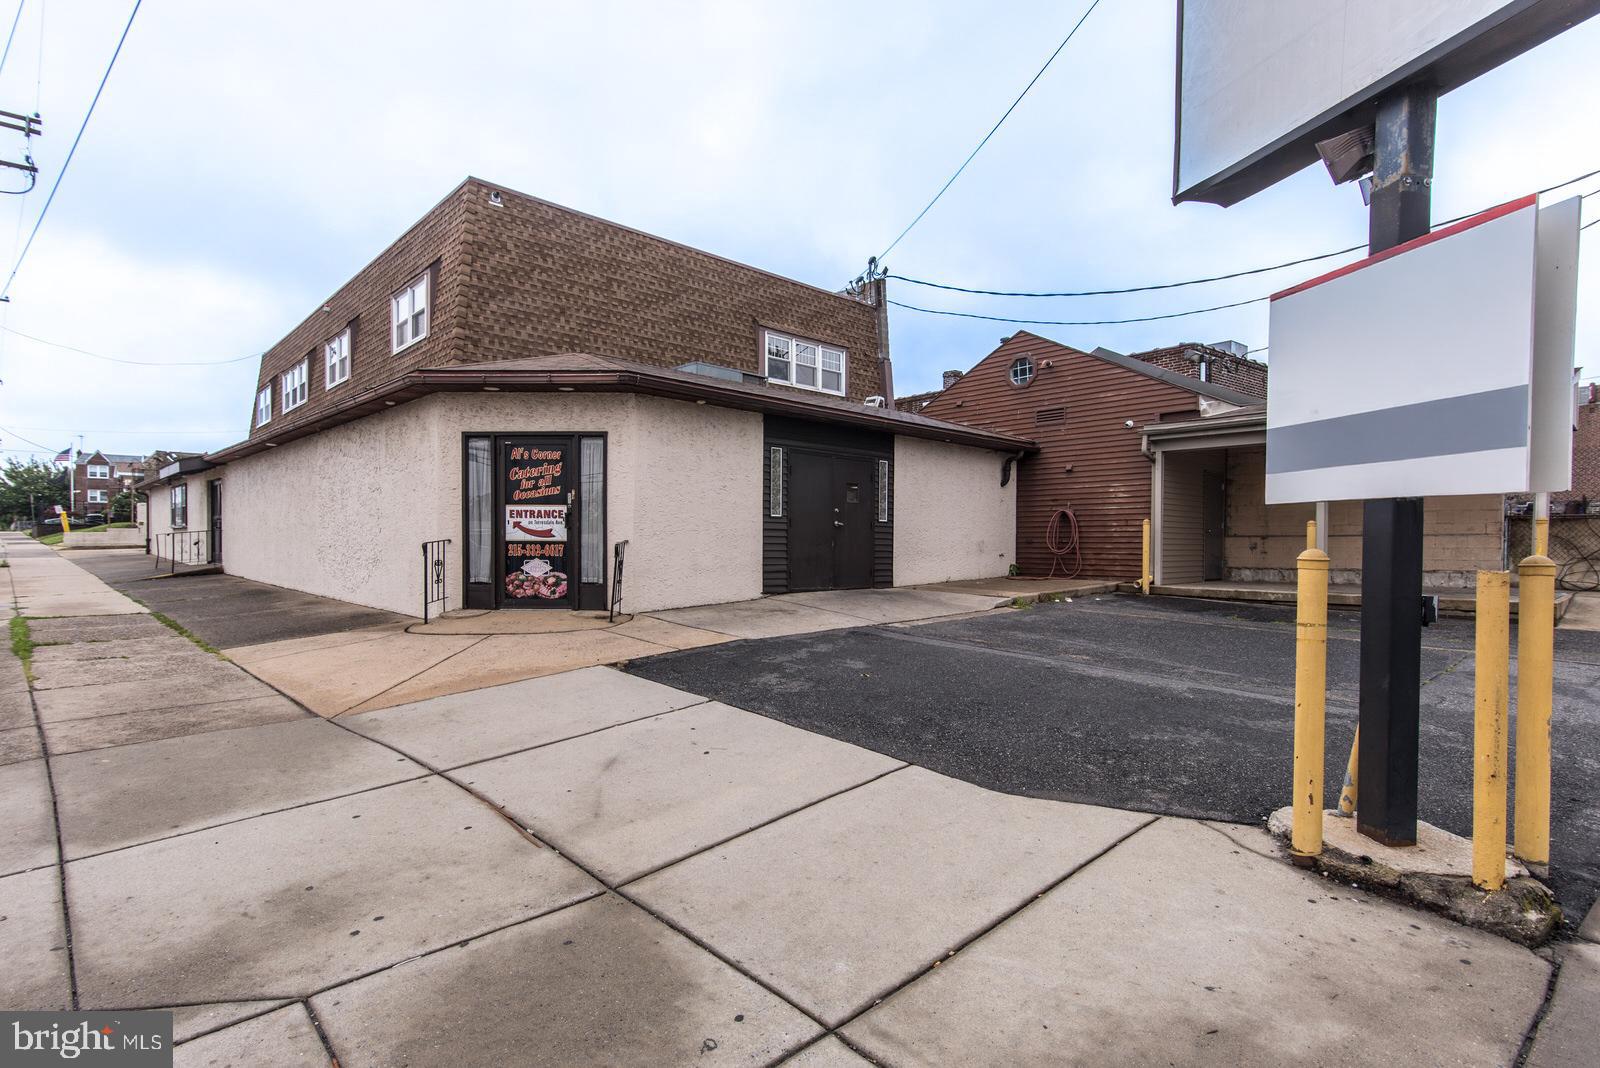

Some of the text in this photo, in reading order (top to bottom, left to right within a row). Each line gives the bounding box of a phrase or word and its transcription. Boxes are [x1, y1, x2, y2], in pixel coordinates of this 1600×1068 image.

[511, 447, 561, 459] Al's Corner
[510, 462, 562, 480] Catering
[520, 475, 552, 489] for all
[513, 486, 560, 500] Occasions
[509, 509, 564, 518] ENTRANCE
